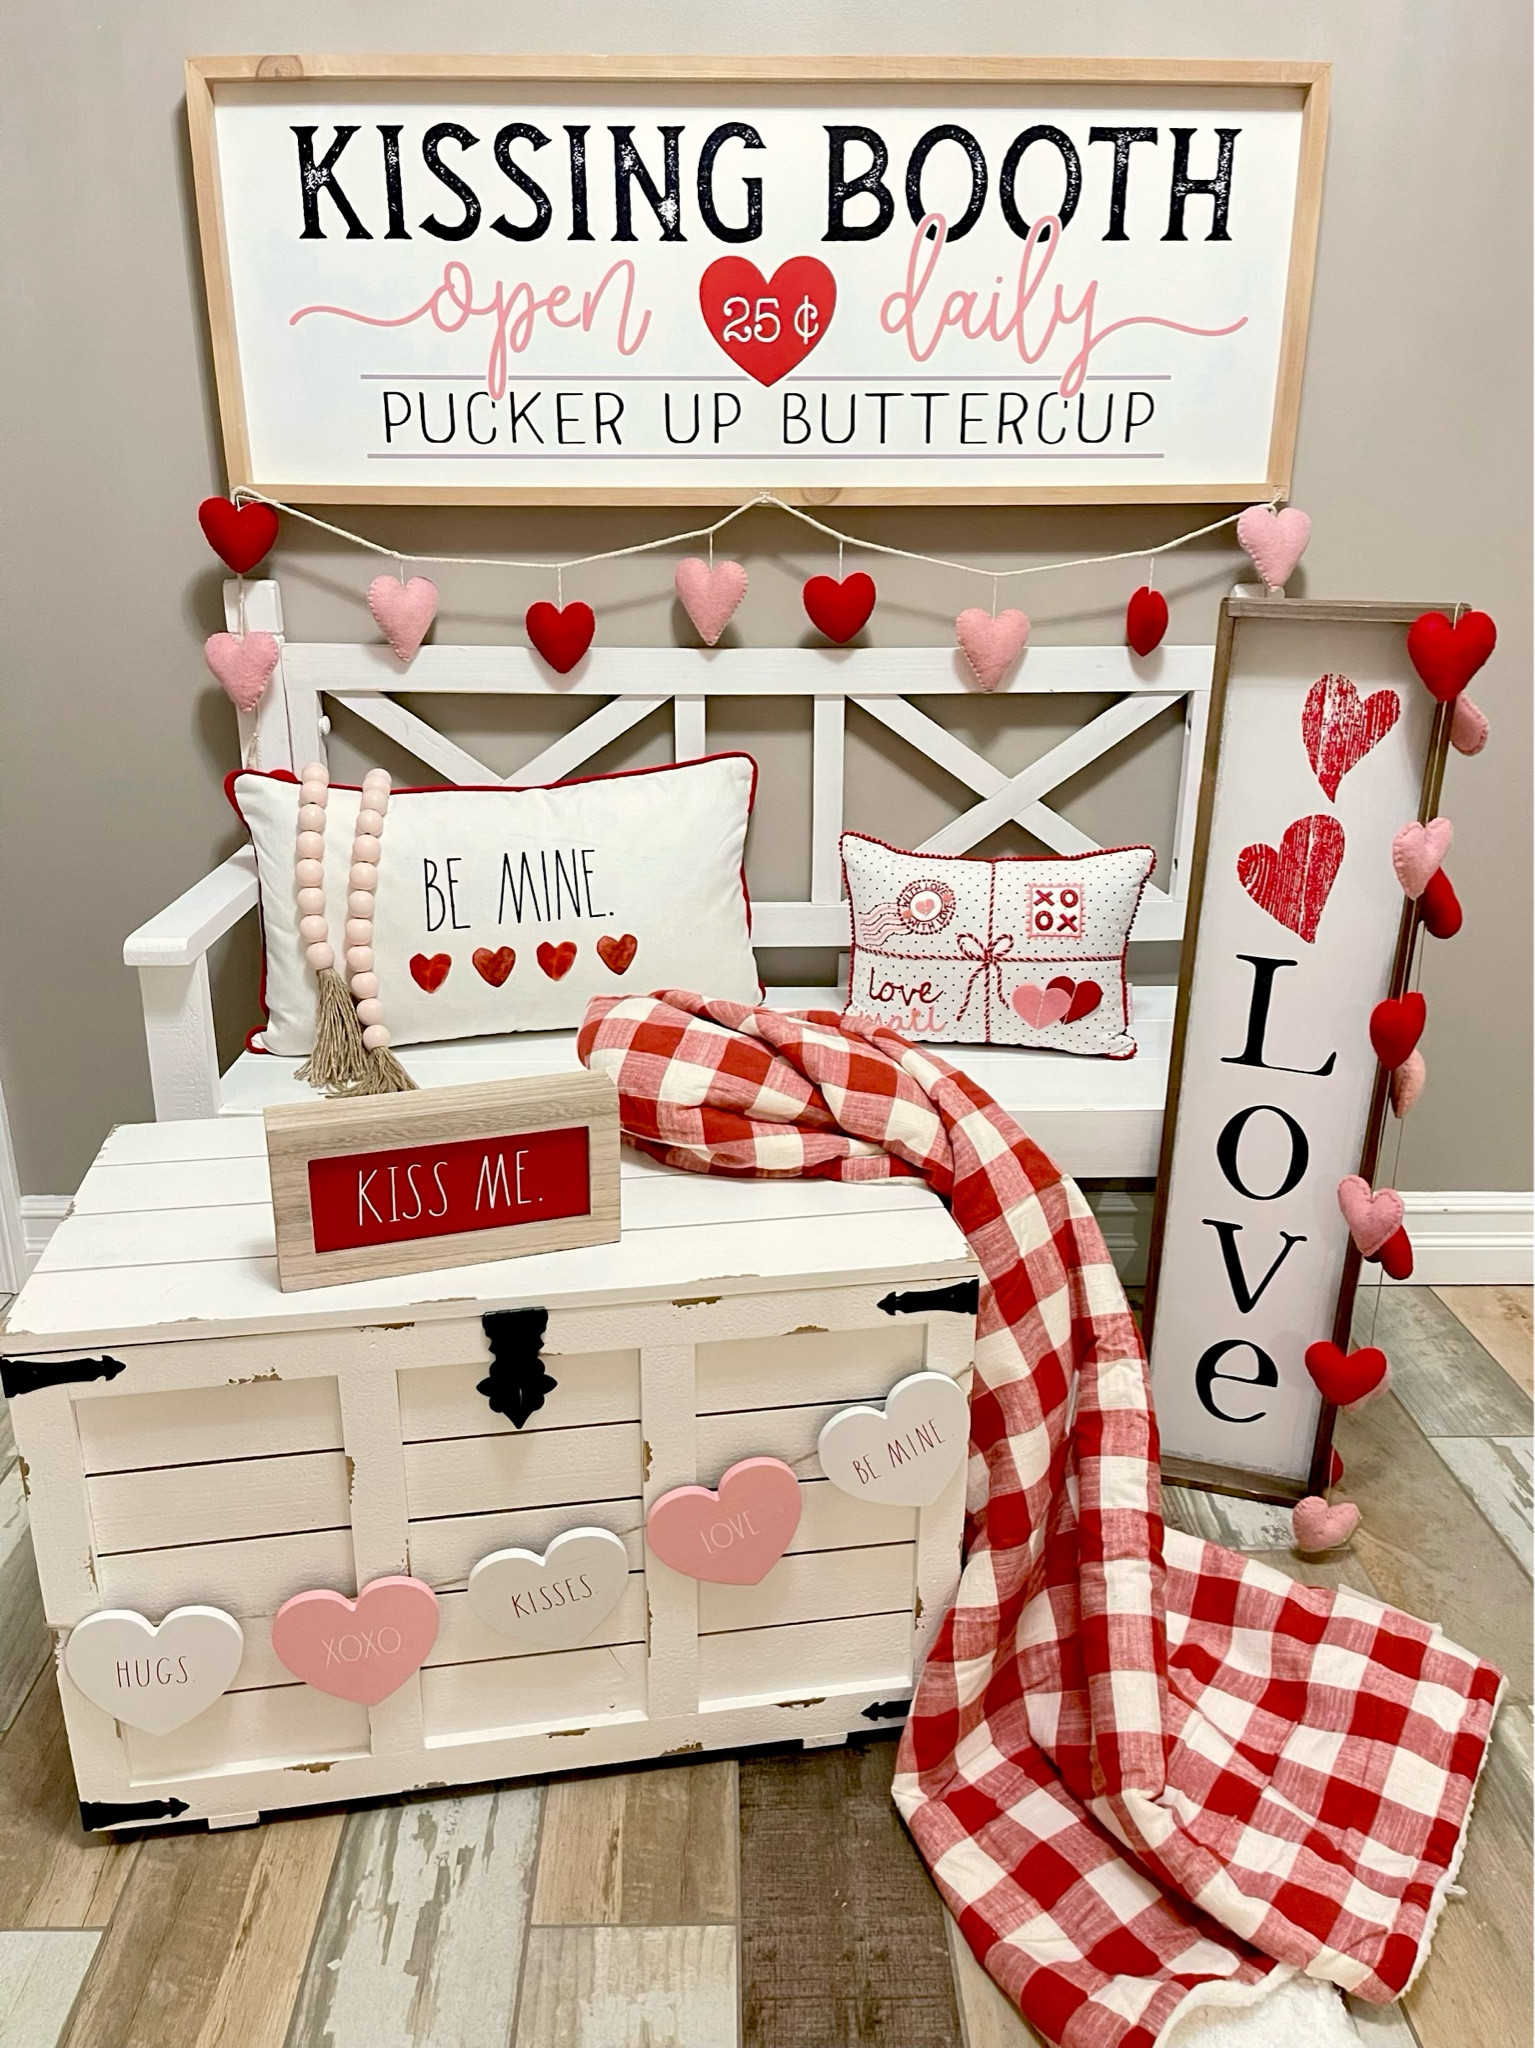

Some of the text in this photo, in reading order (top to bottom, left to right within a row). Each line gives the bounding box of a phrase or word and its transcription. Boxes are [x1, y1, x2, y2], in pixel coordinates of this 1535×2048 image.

[290, 121, 1242, 244] KISSING BOOTH
[289, 213, 1249, 401] open daily
[384, 391, 1155, 445] PUCKER UP BUTTERCUP
[423, 848, 615, 932] BE MINE.
[869, 967, 944, 1007] love
[358, 1149, 544, 1227] KISS ME.
[852, 1454, 881, 1485] BE
[321, 1626, 402, 1667] XOXO
